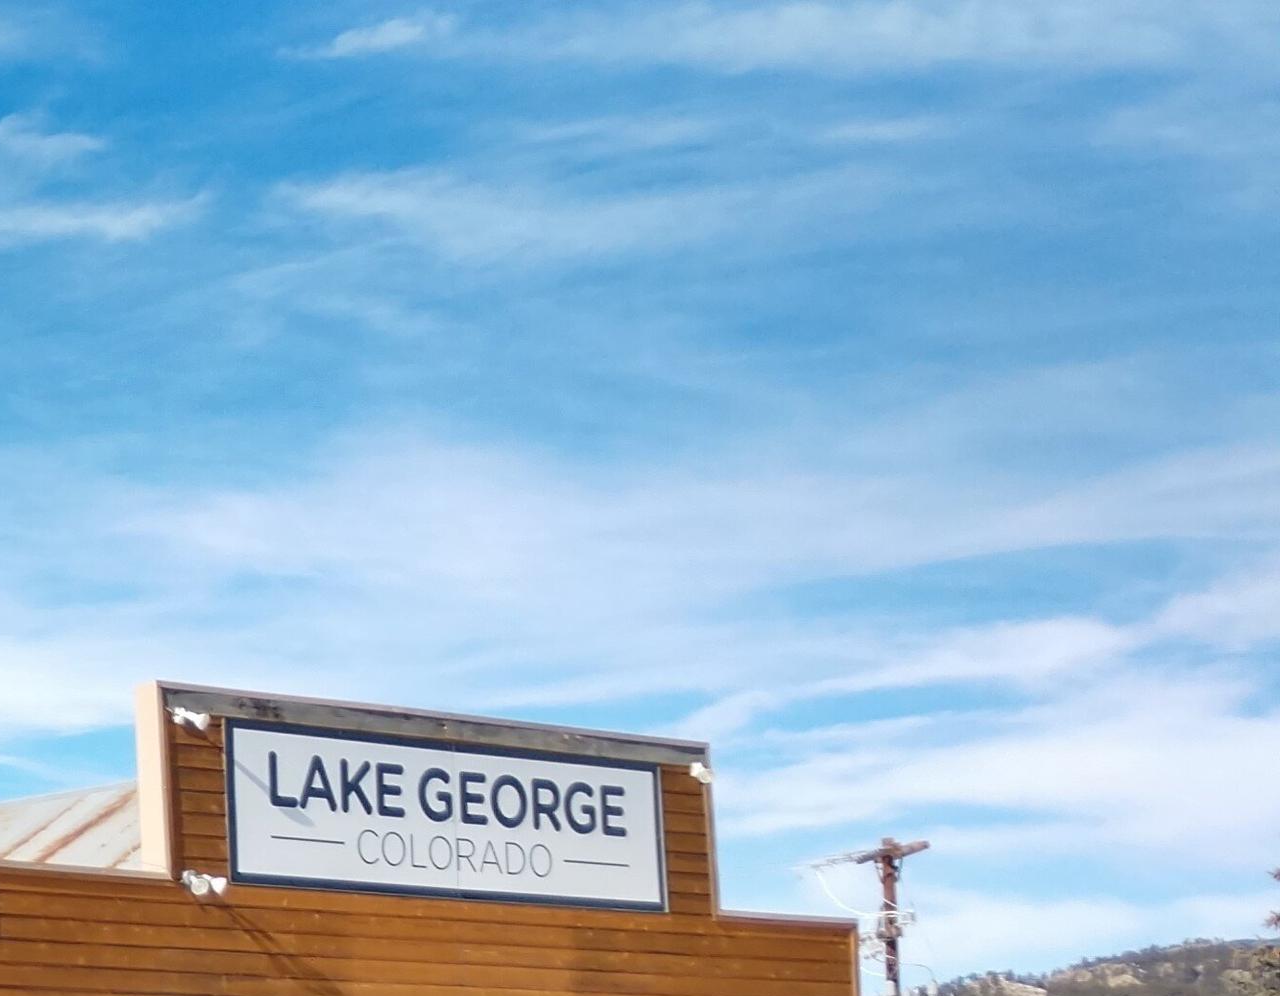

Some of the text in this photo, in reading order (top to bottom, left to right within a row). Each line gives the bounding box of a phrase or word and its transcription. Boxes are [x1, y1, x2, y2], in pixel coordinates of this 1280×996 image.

[268, 750, 628, 837] LAKE GEORGE
[356, 828, 553, 878] COLORADO
